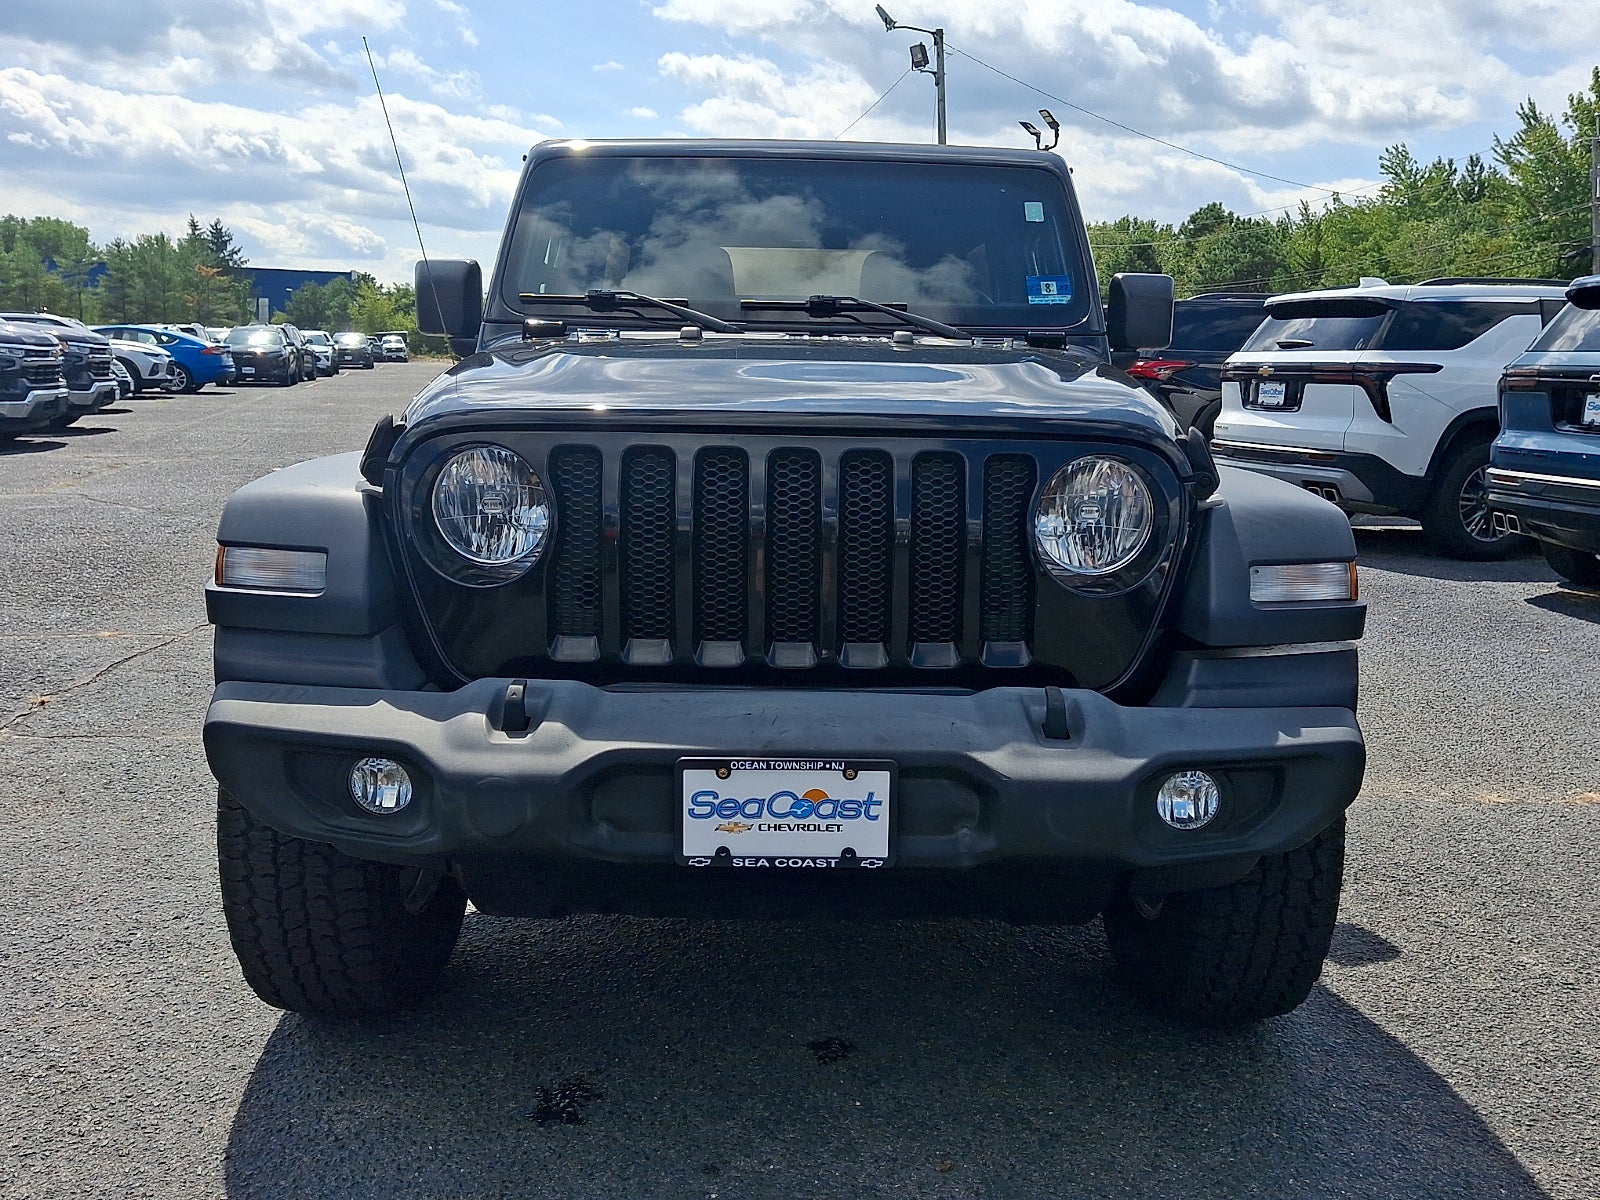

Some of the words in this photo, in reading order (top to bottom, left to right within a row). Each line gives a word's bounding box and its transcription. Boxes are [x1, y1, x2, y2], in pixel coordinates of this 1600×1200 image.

[1044, 283, 1052, 293] 8
[730, 761, 767, 770] OCEAN
[769, 761, 824, 771] TOWNSHIP
[831, 762, 845, 770] NJ
[758, 823, 844, 833] CHEVROLET
[732, 858, 770, 868] SEA
[774, 858, 840, 868] COAST
